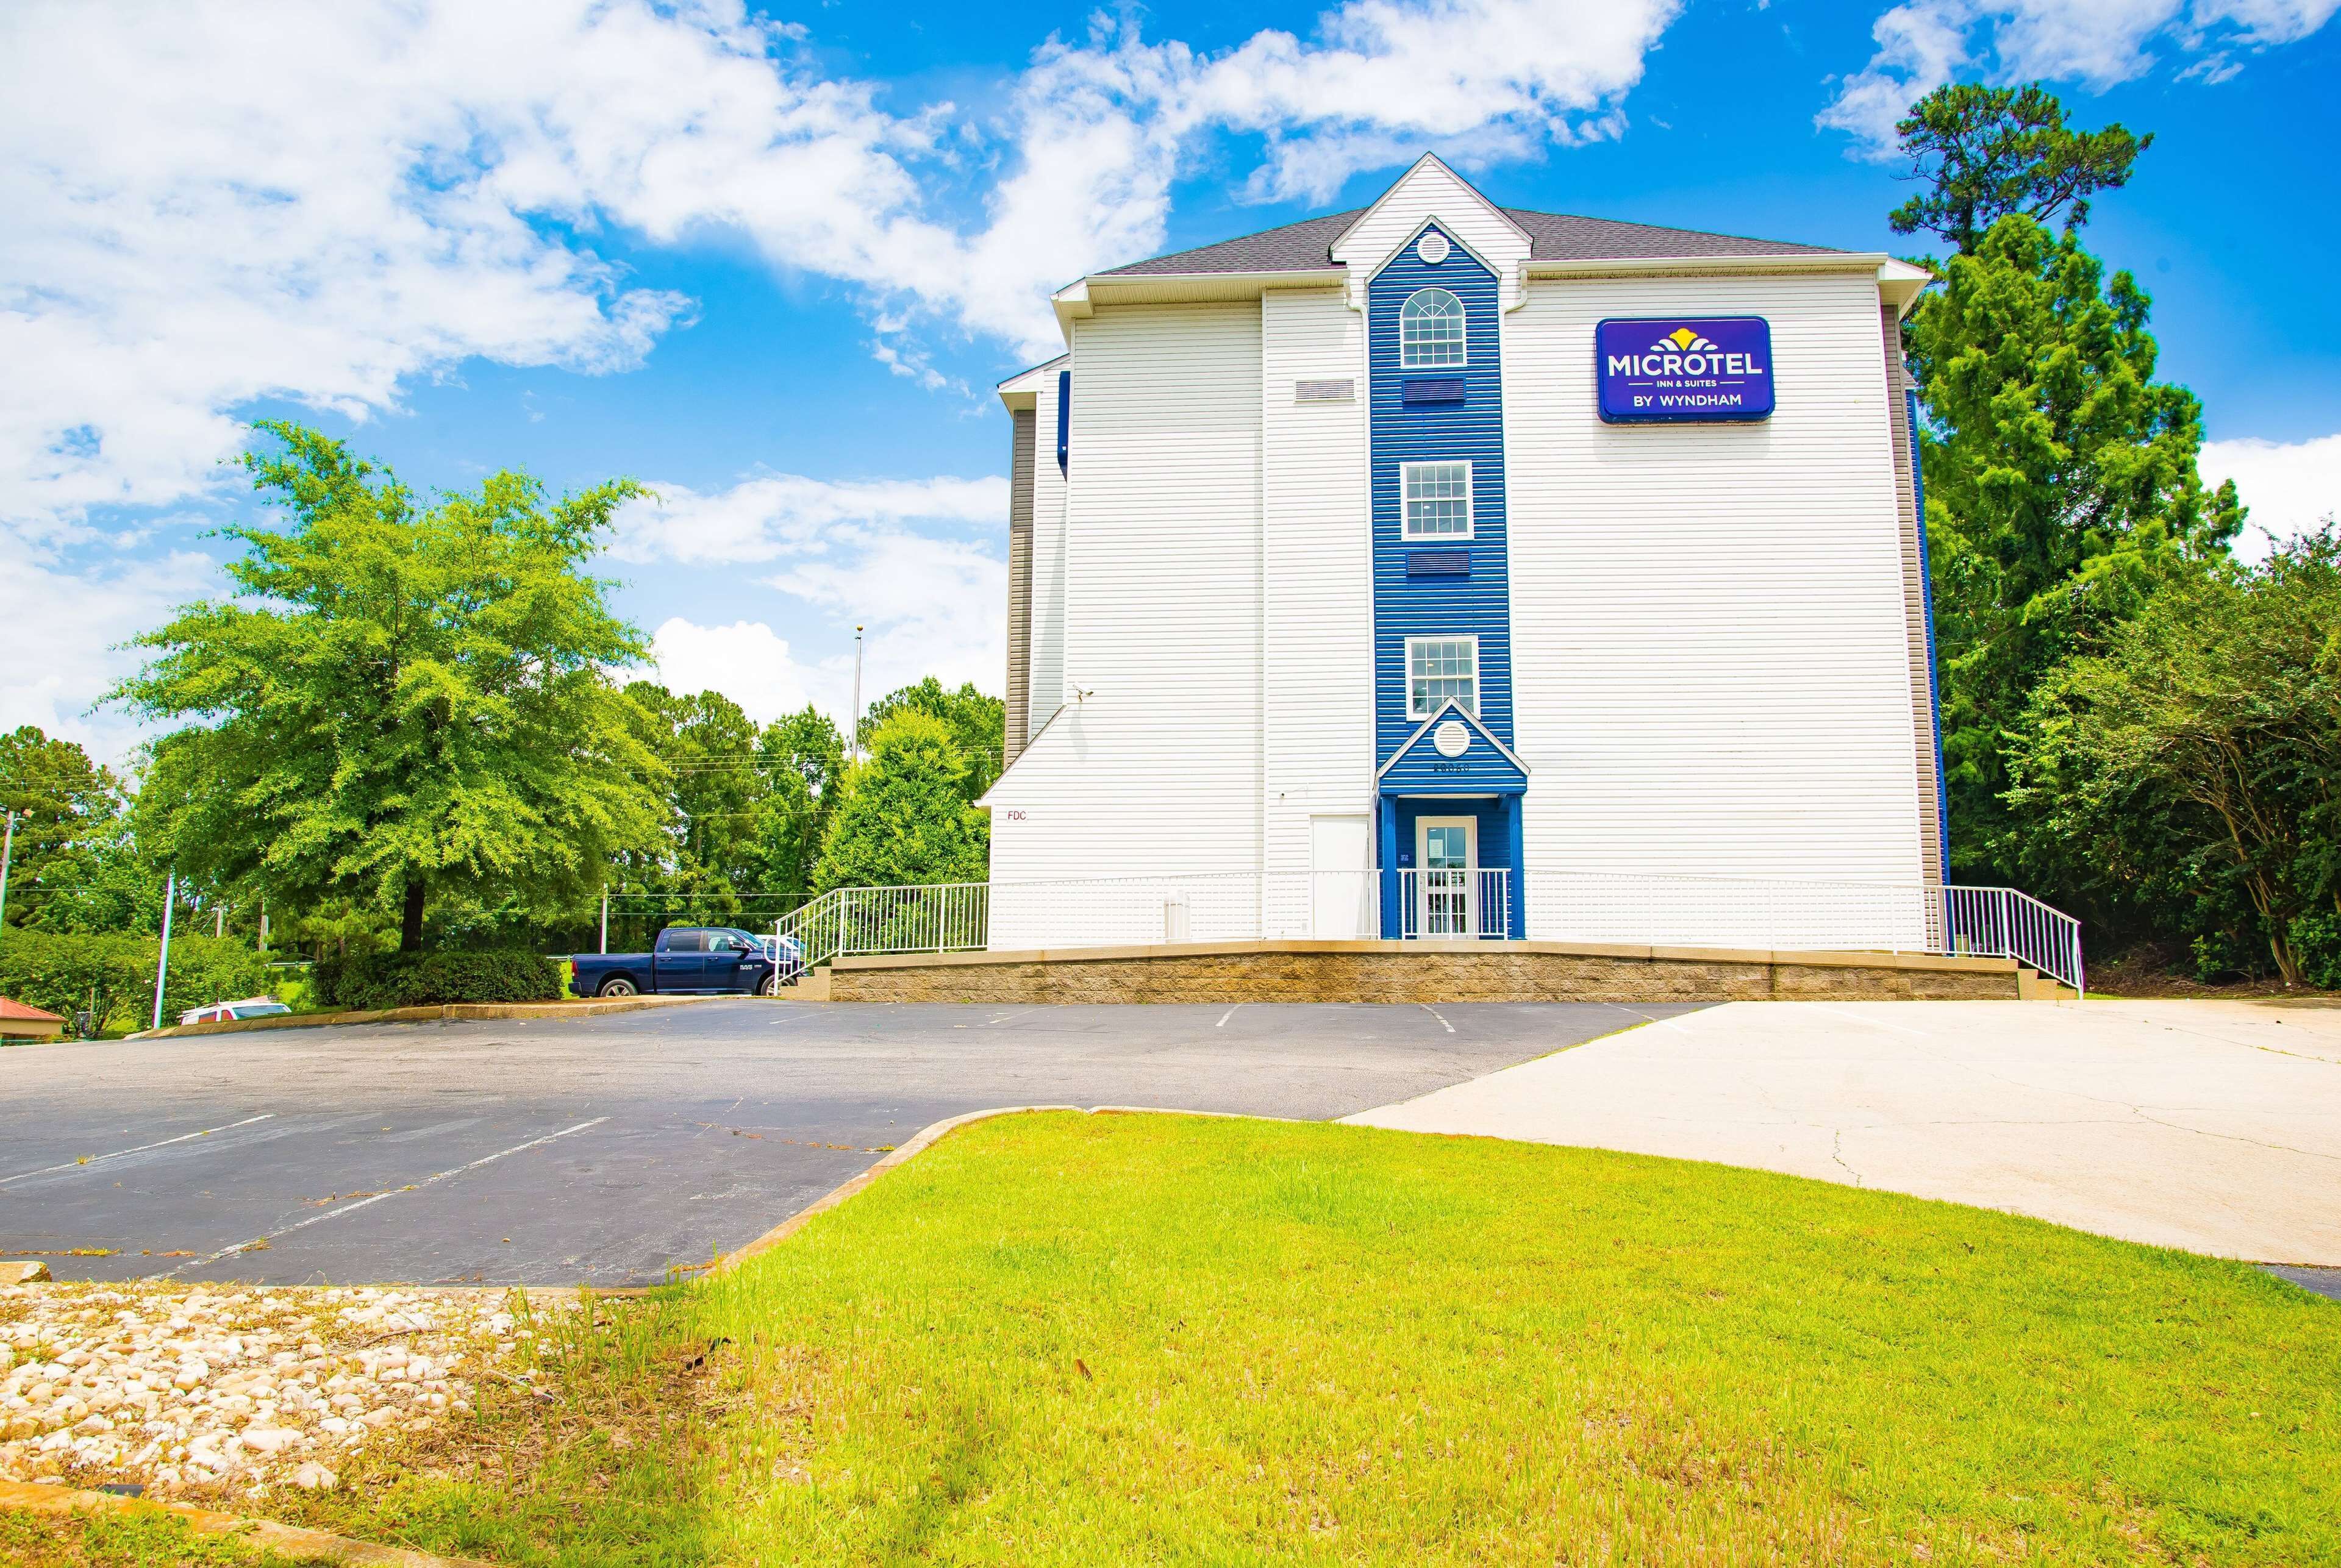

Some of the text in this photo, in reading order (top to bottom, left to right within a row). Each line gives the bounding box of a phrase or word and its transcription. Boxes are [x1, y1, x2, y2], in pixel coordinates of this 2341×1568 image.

[1607, 353, 1763, 377] MICROTEL
[1634, 394, 1742, 407] BY WYNDHAM
[1007, 811, 1026, 820] FDC
